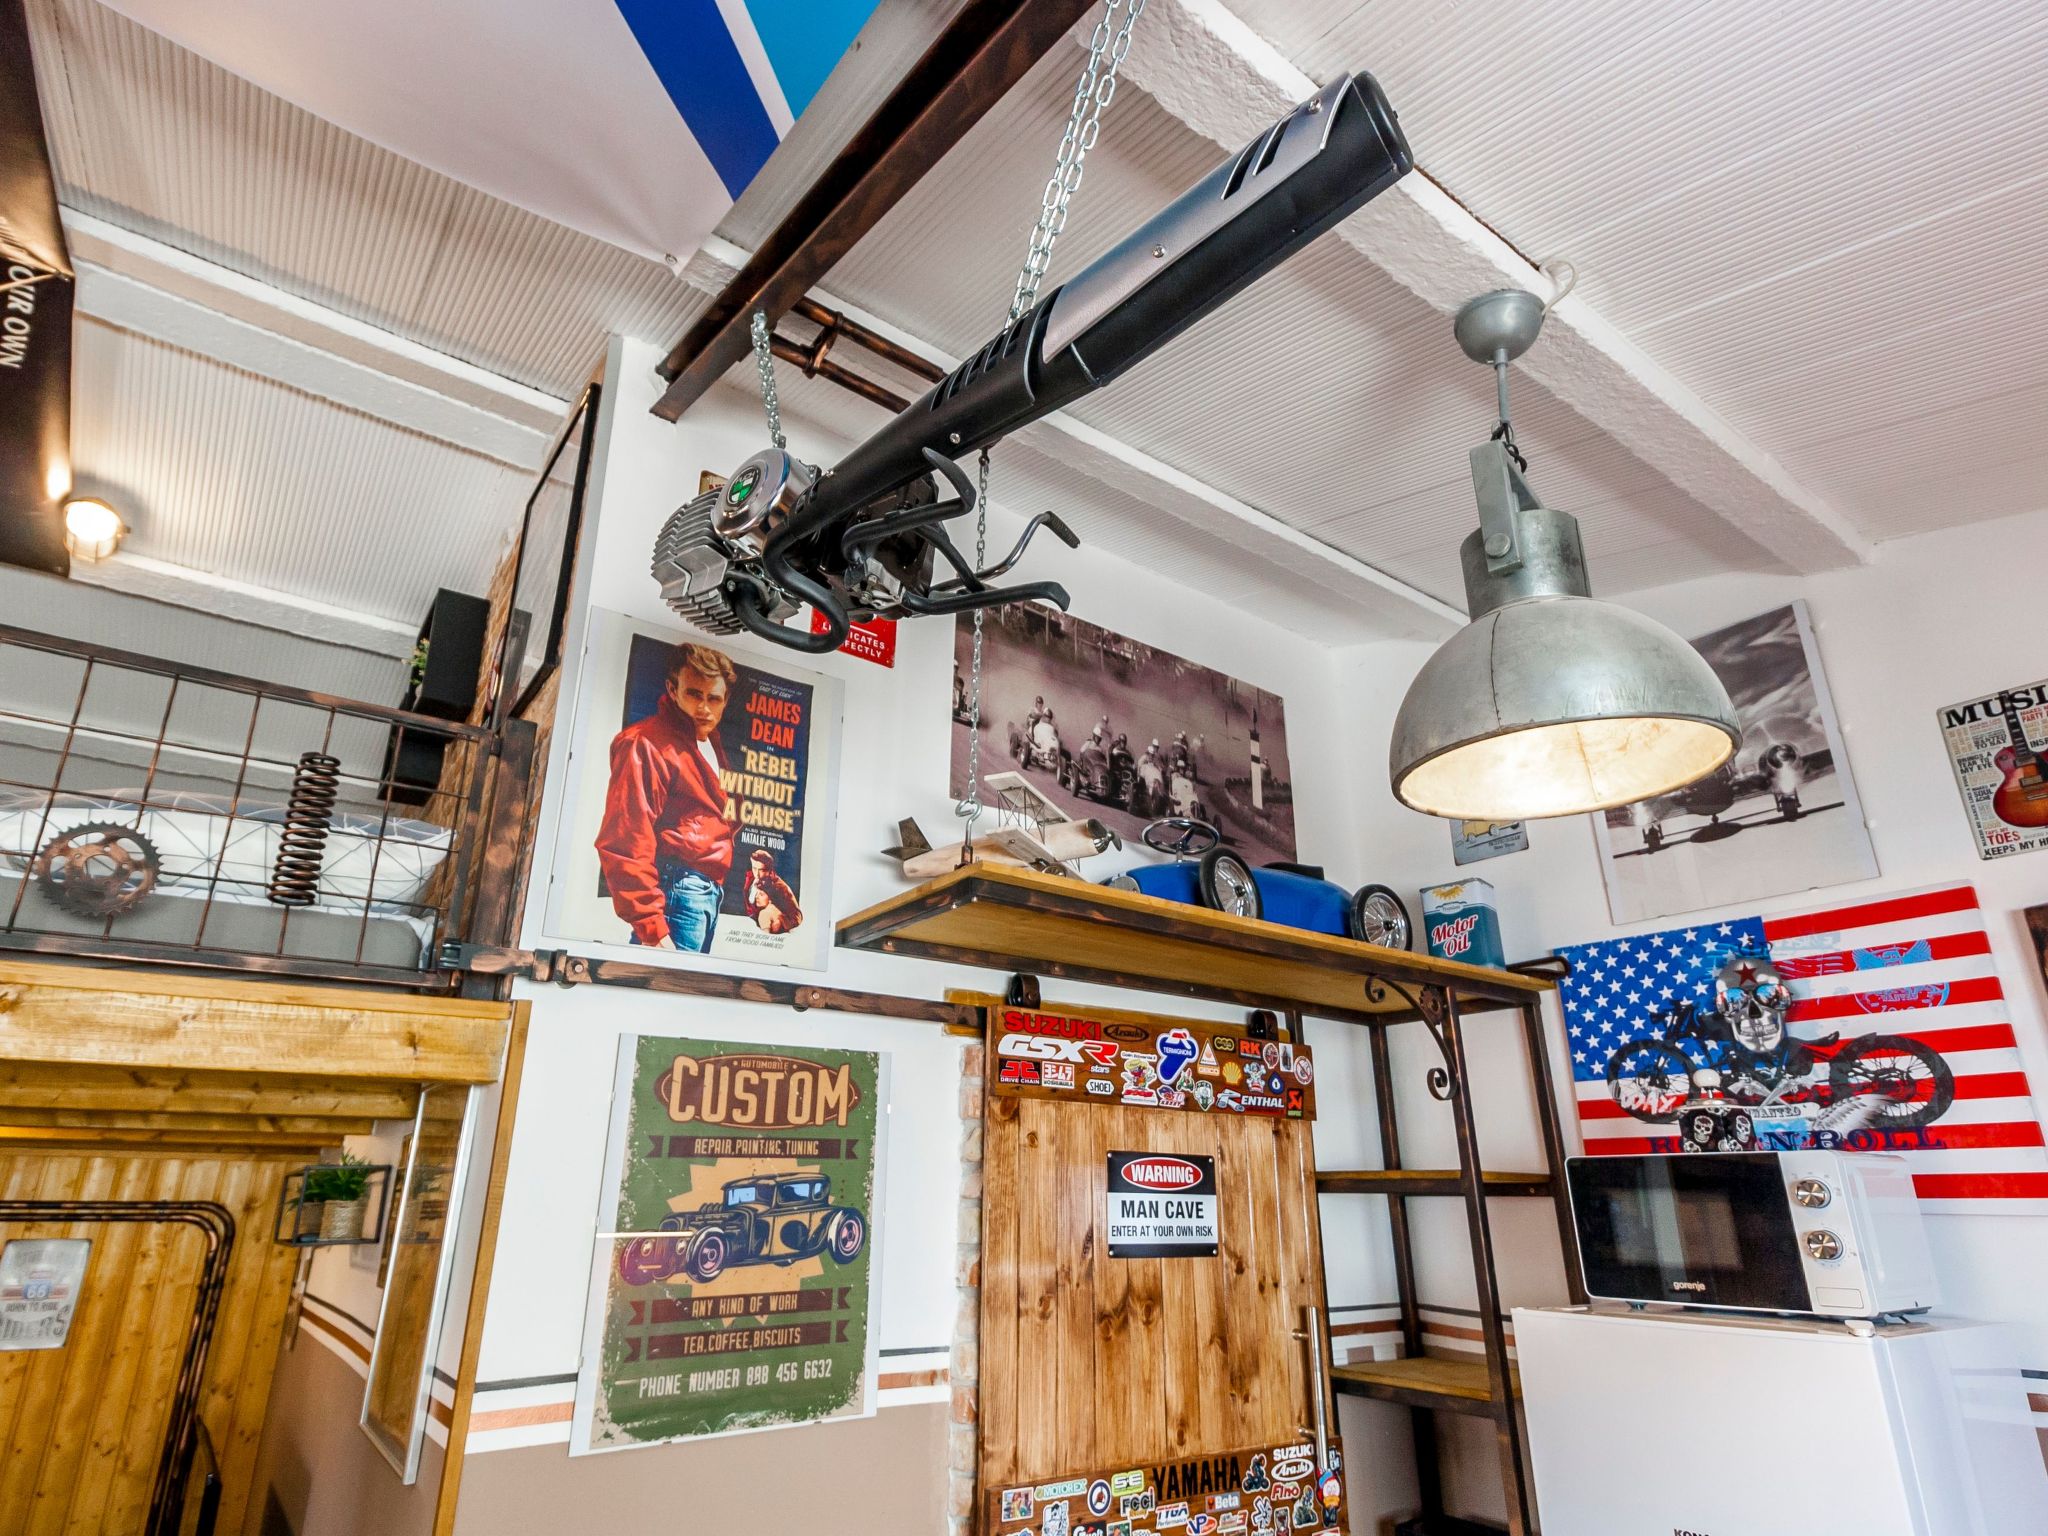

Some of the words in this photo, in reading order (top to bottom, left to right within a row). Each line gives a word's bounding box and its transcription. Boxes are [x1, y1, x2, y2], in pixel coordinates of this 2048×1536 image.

[746, 692, 801, 725] JAMES
[751, 718, 795, 749] DEAN
[720, 768, 796, 806] WITHOUT
[722, 798, 737, 822] A
[742, 832, 766, 848] NATALIE
[768, 836, 786, 851] WOOD
[1984, 844, 2016, 856] KEEPS
[2020, 840, 2034, 850] MY
[1986, 831, 2021, 846] TOES
[1432, 914, 1478, 947] Motor
[1443, 932, 1471, 957] Oil
[1004, 1011, 1101, 1040] SUZUKI
[1240, 1040, 1260, 1055] RK
[740, 1059, 789, 1070] AUTOMOBILE
[669, 1056, 850, 1126] CUSTOM
[1090, 1082, 1110, 1093] SHOEI
[1130, 1164, 1194, 1184] WARNING
[1121, 1200, 1159, 1218] MAN
[1164, 1200, 1204, 1219] CAVE
[1112, 1226, 1138, 1237] ENTER
[1140, 1226, 1150, 1237] AT
[1152, 1226, 1174, 1237] YOUR
[1176, 1226, 1194, 1237] OWN
[1196, 1226, 1213, 1237] RISK
[27, 1284, 48, 1299] 66
[1673, 1280, 1706, 1292] gorenje
[692, 1299, 713, 1318] ANY
[750, 1296, 763, 1312] OF
[639, 1374, 682, 1398] PHONE
[689, 1368, 740, 1392] NUMBER
[746, 1365, 770, 1386] 888
[776, 1362, 798, 1383] 456
[804, 1358, 833, 1380] 6632
[1273, 1444, 1314, 1460] SUZUKI
[1152, 1456, 1241, 1500] YAMAHA
[1043, 1480, 1086, 1498] MOTOREX
[1215, 1494, 1239, 1509] Beta
[1189, 1515, 1207, 1534] VP
